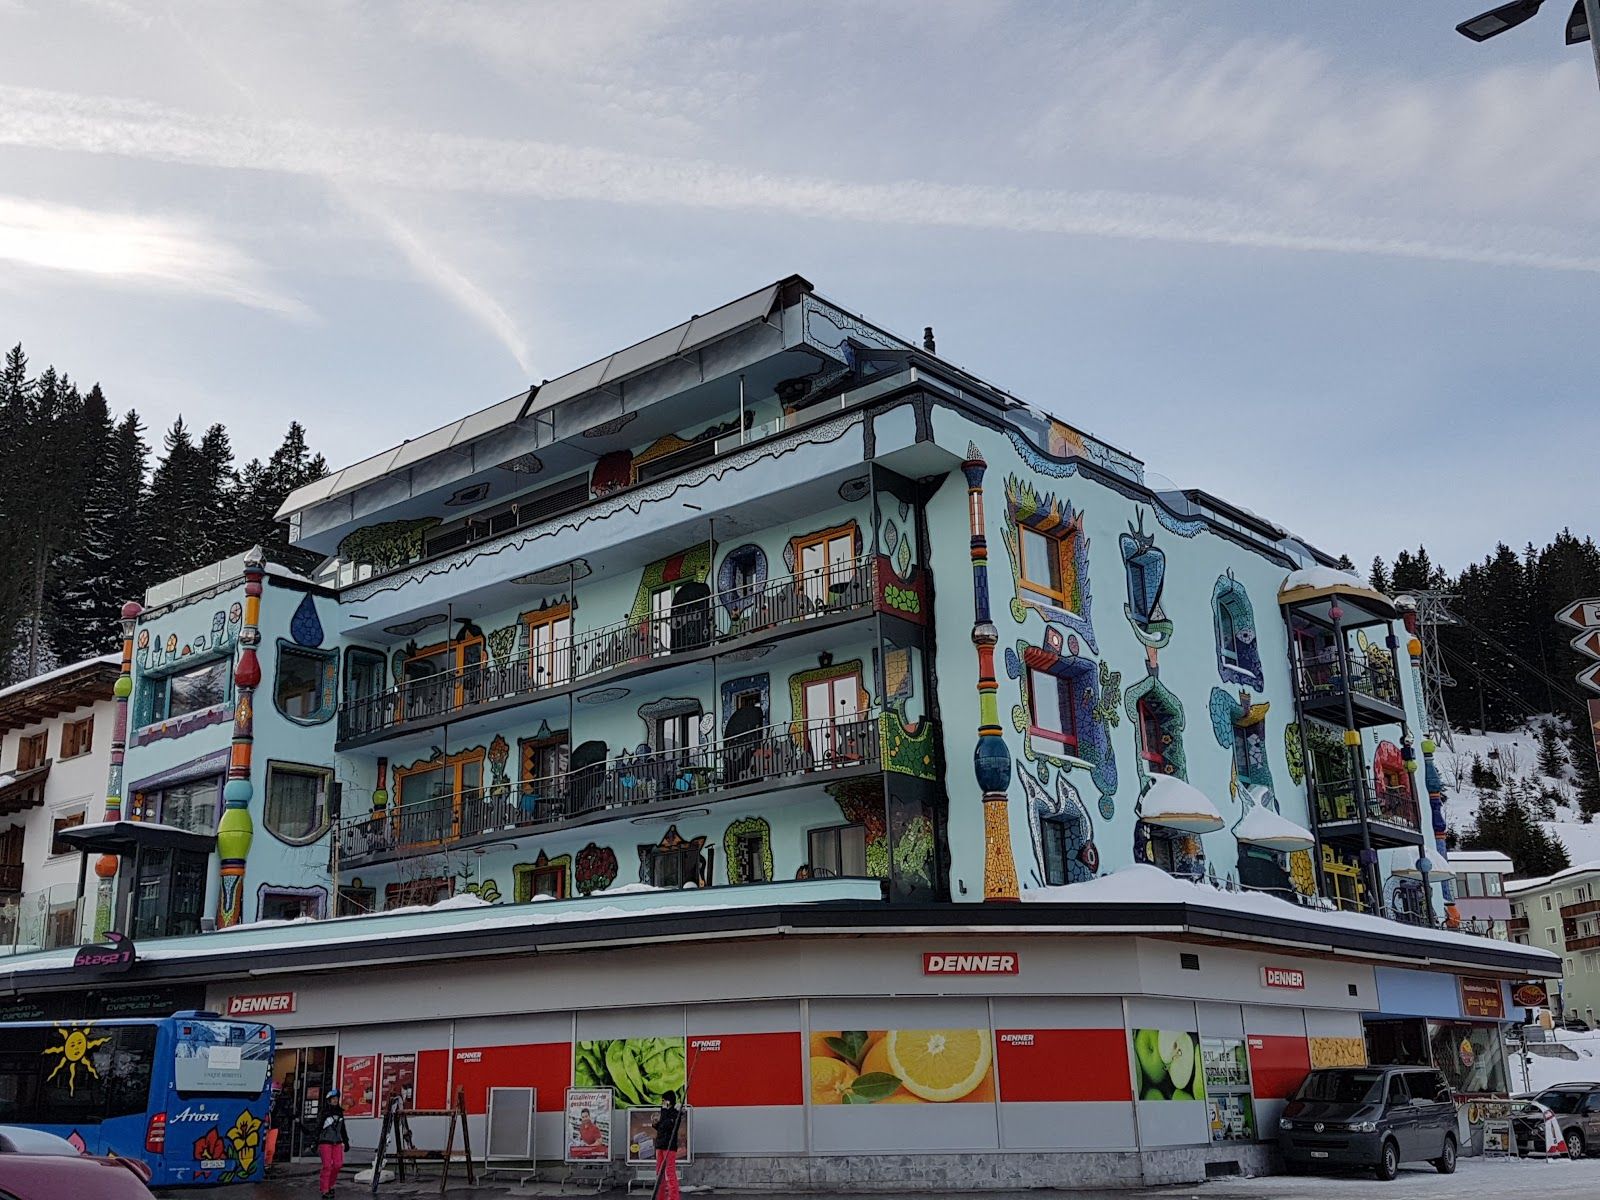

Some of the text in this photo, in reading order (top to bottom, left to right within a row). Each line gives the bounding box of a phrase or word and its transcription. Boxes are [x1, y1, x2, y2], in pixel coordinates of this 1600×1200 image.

[75, 953, 120, 966] Stage
[928, 955, 1015, 972] DENNER
[1267, 969, 1303, 988] DENNER
[230, 995, 290, 1014] DENNER
[1000, 1034, 1035, 1042] DENNER
[456, 1052, 482, 1060] DENNER
[169, 1106, 220, 1124] Arosa
